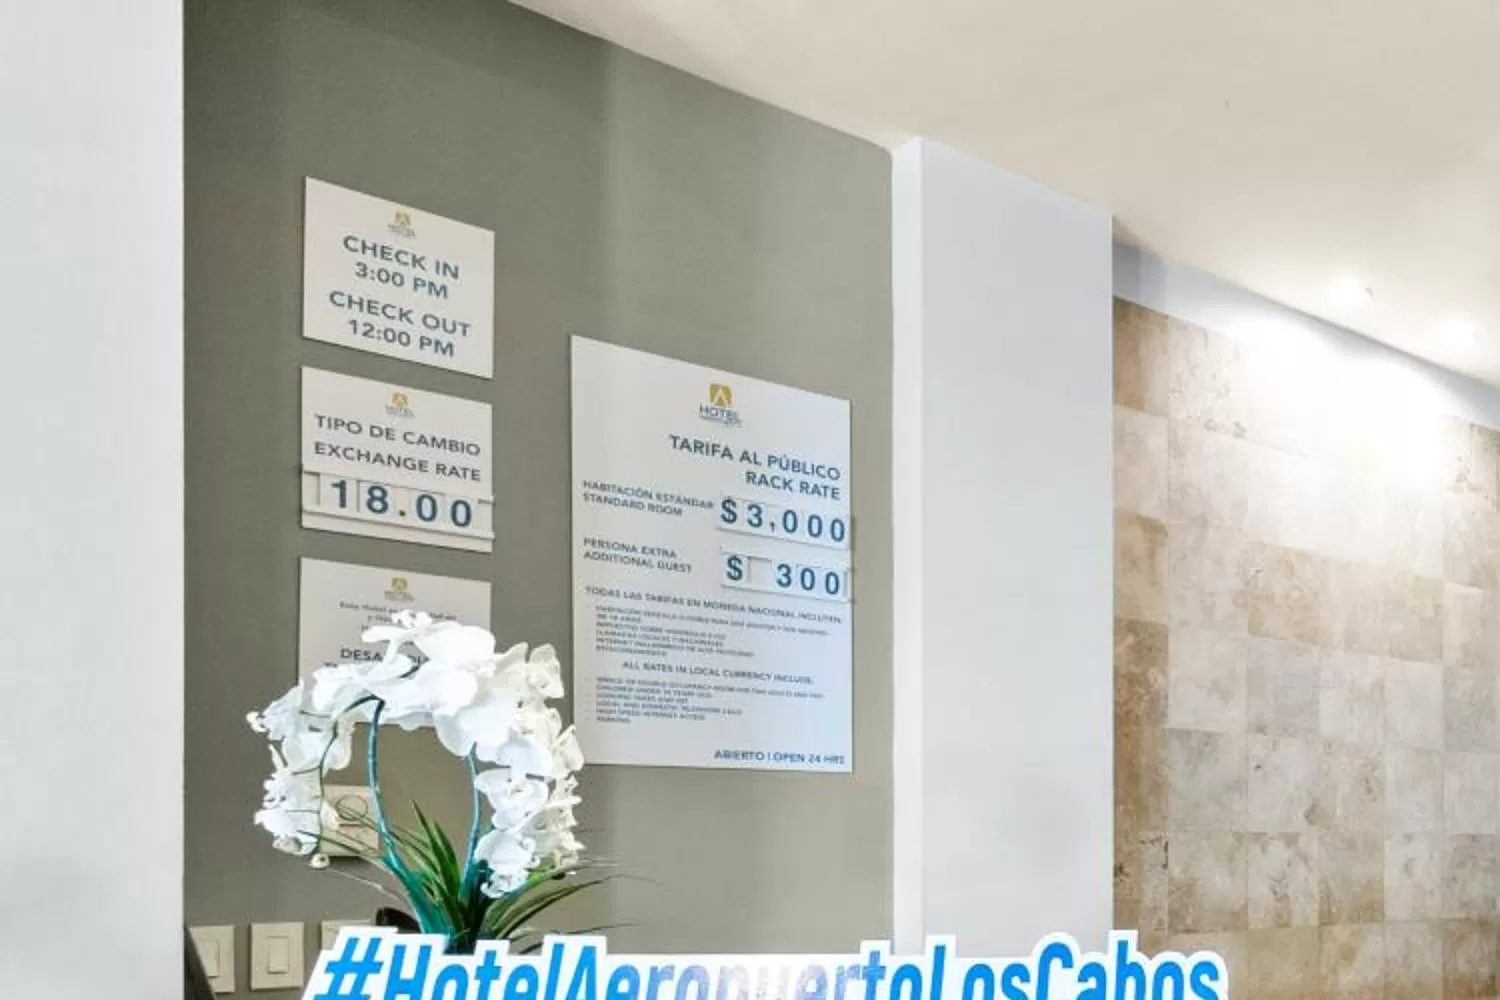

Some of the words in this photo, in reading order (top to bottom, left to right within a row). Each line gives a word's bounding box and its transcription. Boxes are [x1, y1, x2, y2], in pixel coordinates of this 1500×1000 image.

[343, 235, 427, 271] CHECK
[435, 260, 460, 280] IN
[355, 262, 405, 287] 3:00
[413, 278, 448, 299] PM
[329, 291, 414, 325] CHECK
[422, 314, 471, 337] OUT
[348, 319, 410, 347] 12:00
[419, 336, 454, 357] PM
[315, 414, 363, 435] TIPO
[369, 425, 396, 441] DE
[403, 431, 481, 456] CAMBIO
[314, 441, 430, 473] EXCHANGE
[435, 463, 481, 481] RATE
[669, 434, 734, 461] TARIFA
[739, 450, 762, 466] AL
[767, 454, 841, 481] PÚBLICO
[331, 479, 472, 527] 18.00
[583, 493, 645, 511] STANDARD
[647, 503, 683, 517] ROOM
[745, 471, 794, 493] RACK
[800, 482, 841, 501] RATE
[720, 496, 845, 543] $3,000
[583, 537, 638, 554] PERSONA
[641, 546, 677, 559] EXTRA
[583, 551, 655, 569] ADDITIONAL
[657, 561, 692, 573] GUEST
[776, 563, 840, 595] 300
[714, 749, 764, 761] ABIERTO
[773, 752, 805, 763] OPEN
[808, 754, 821, 763] 24
[824, 755, 844, 765] HRS
